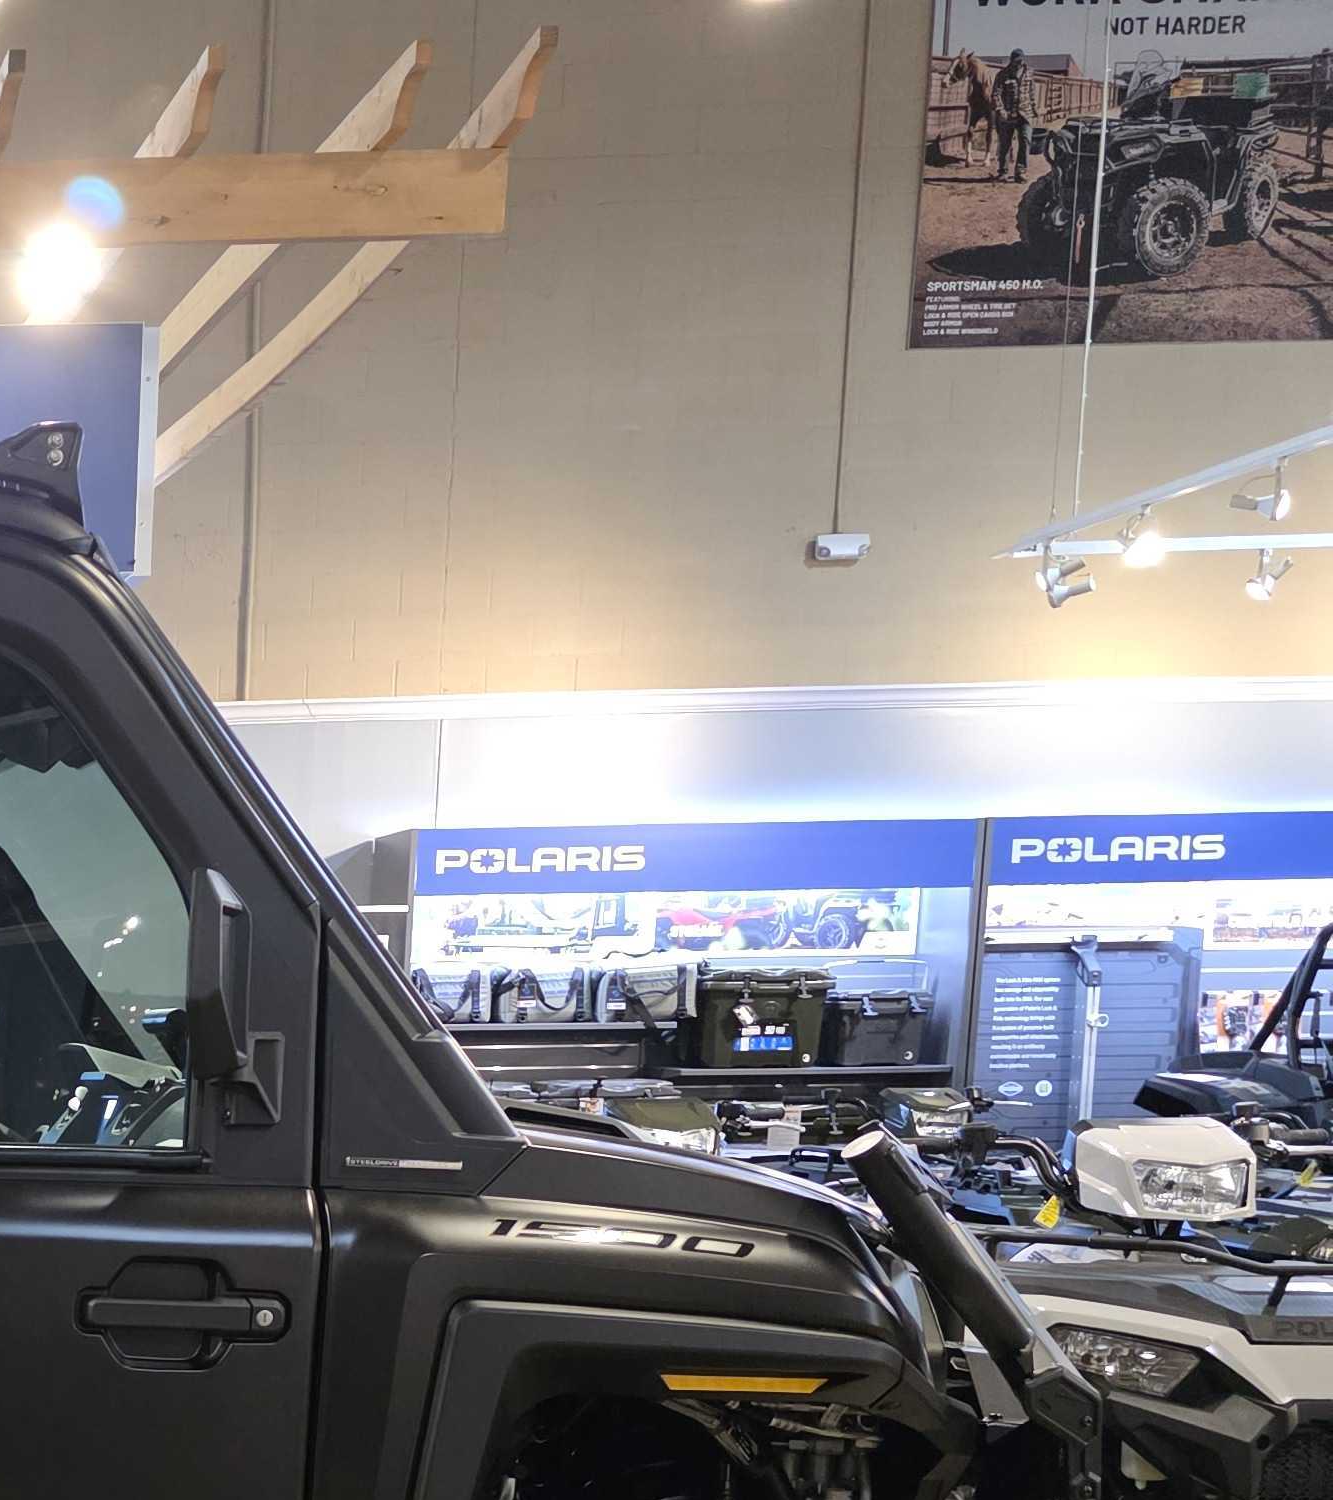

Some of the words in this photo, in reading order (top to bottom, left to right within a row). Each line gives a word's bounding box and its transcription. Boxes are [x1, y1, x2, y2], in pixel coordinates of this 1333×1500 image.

[1105, 16, 1149, 36] NOT
[1156, 15, 1246, 36] HARDER
[926, 281, 997, 292] SPORTSMAN
[999, 280, 1020, 290] 450
[435, 845, 646, 875] POLARIS
[1011, 834, 1227, 864] POLARIS
